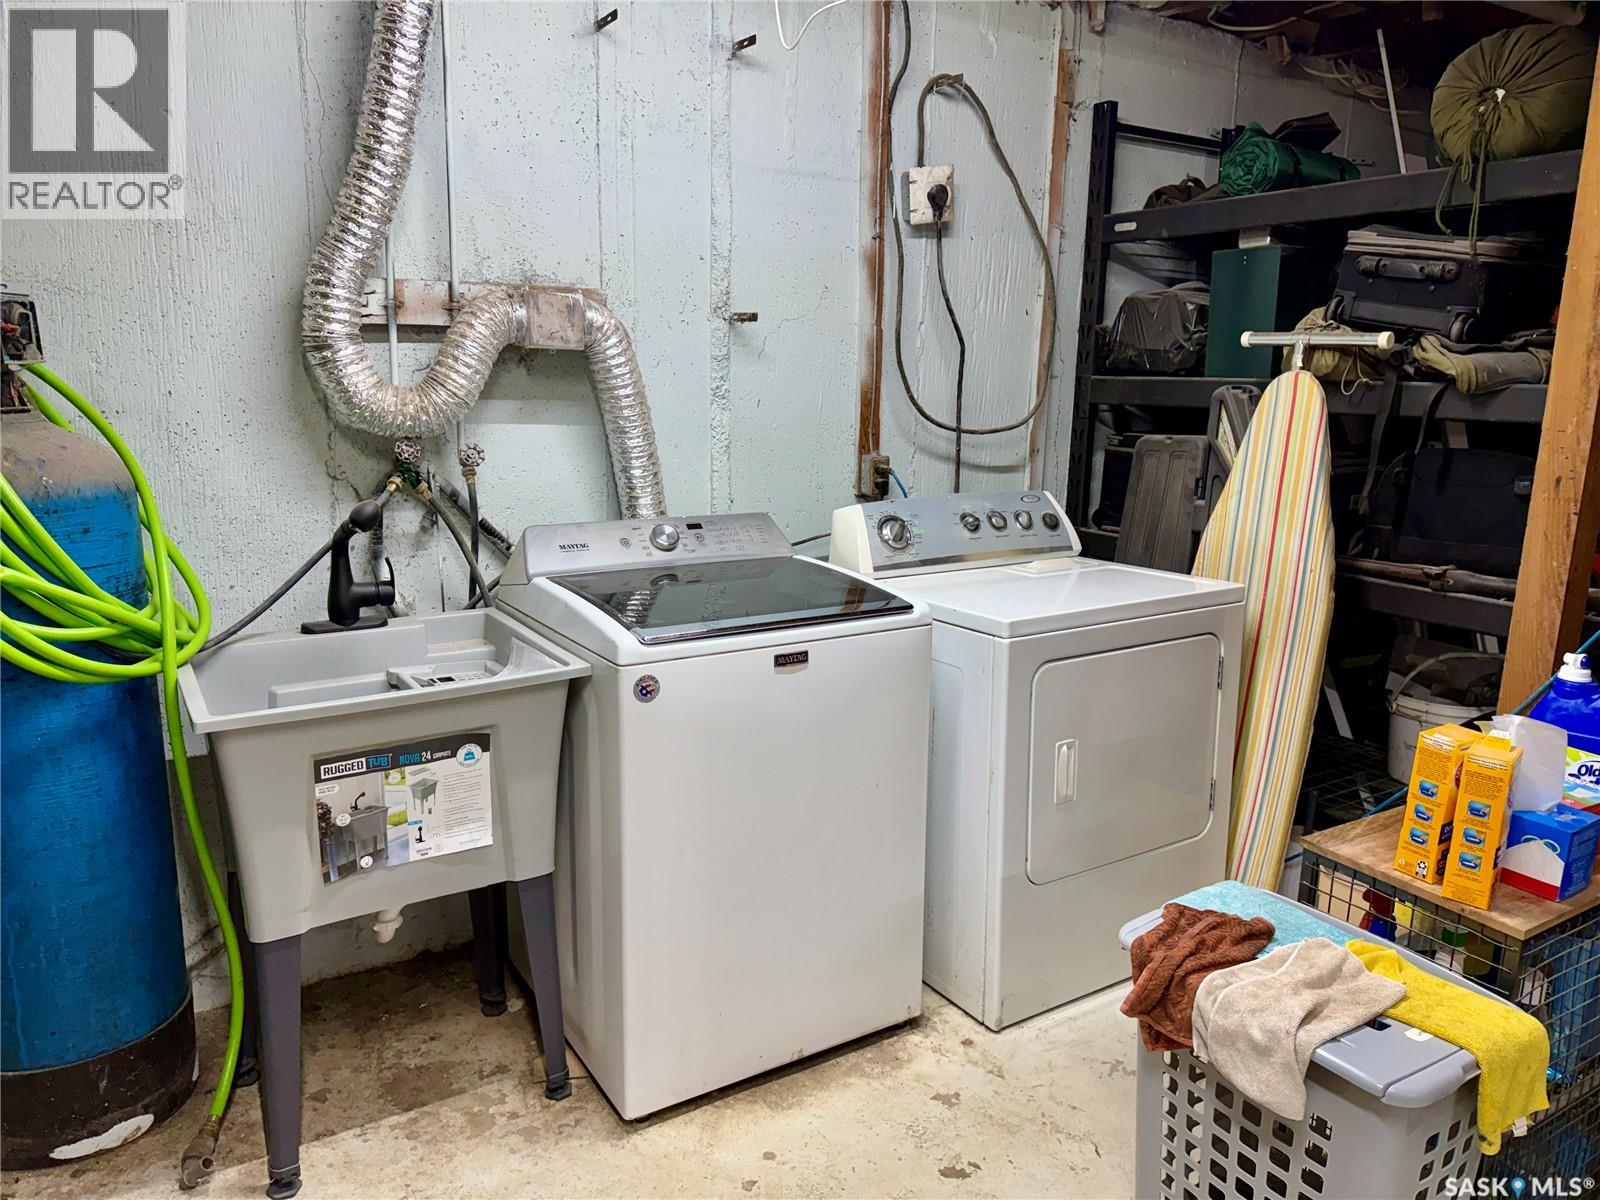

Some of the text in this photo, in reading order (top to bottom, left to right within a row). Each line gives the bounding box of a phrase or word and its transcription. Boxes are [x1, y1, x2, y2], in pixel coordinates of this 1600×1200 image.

[558, 542, 590, 551] MAYTAG
[777, 653, 807, 665] MAYTAG
[323, 760, 364, 777] RUGGED
[367, 756, 389, 769] TUB
[399, 753, 420, 765] NOVA
[421, 749, 432, 762] 24
